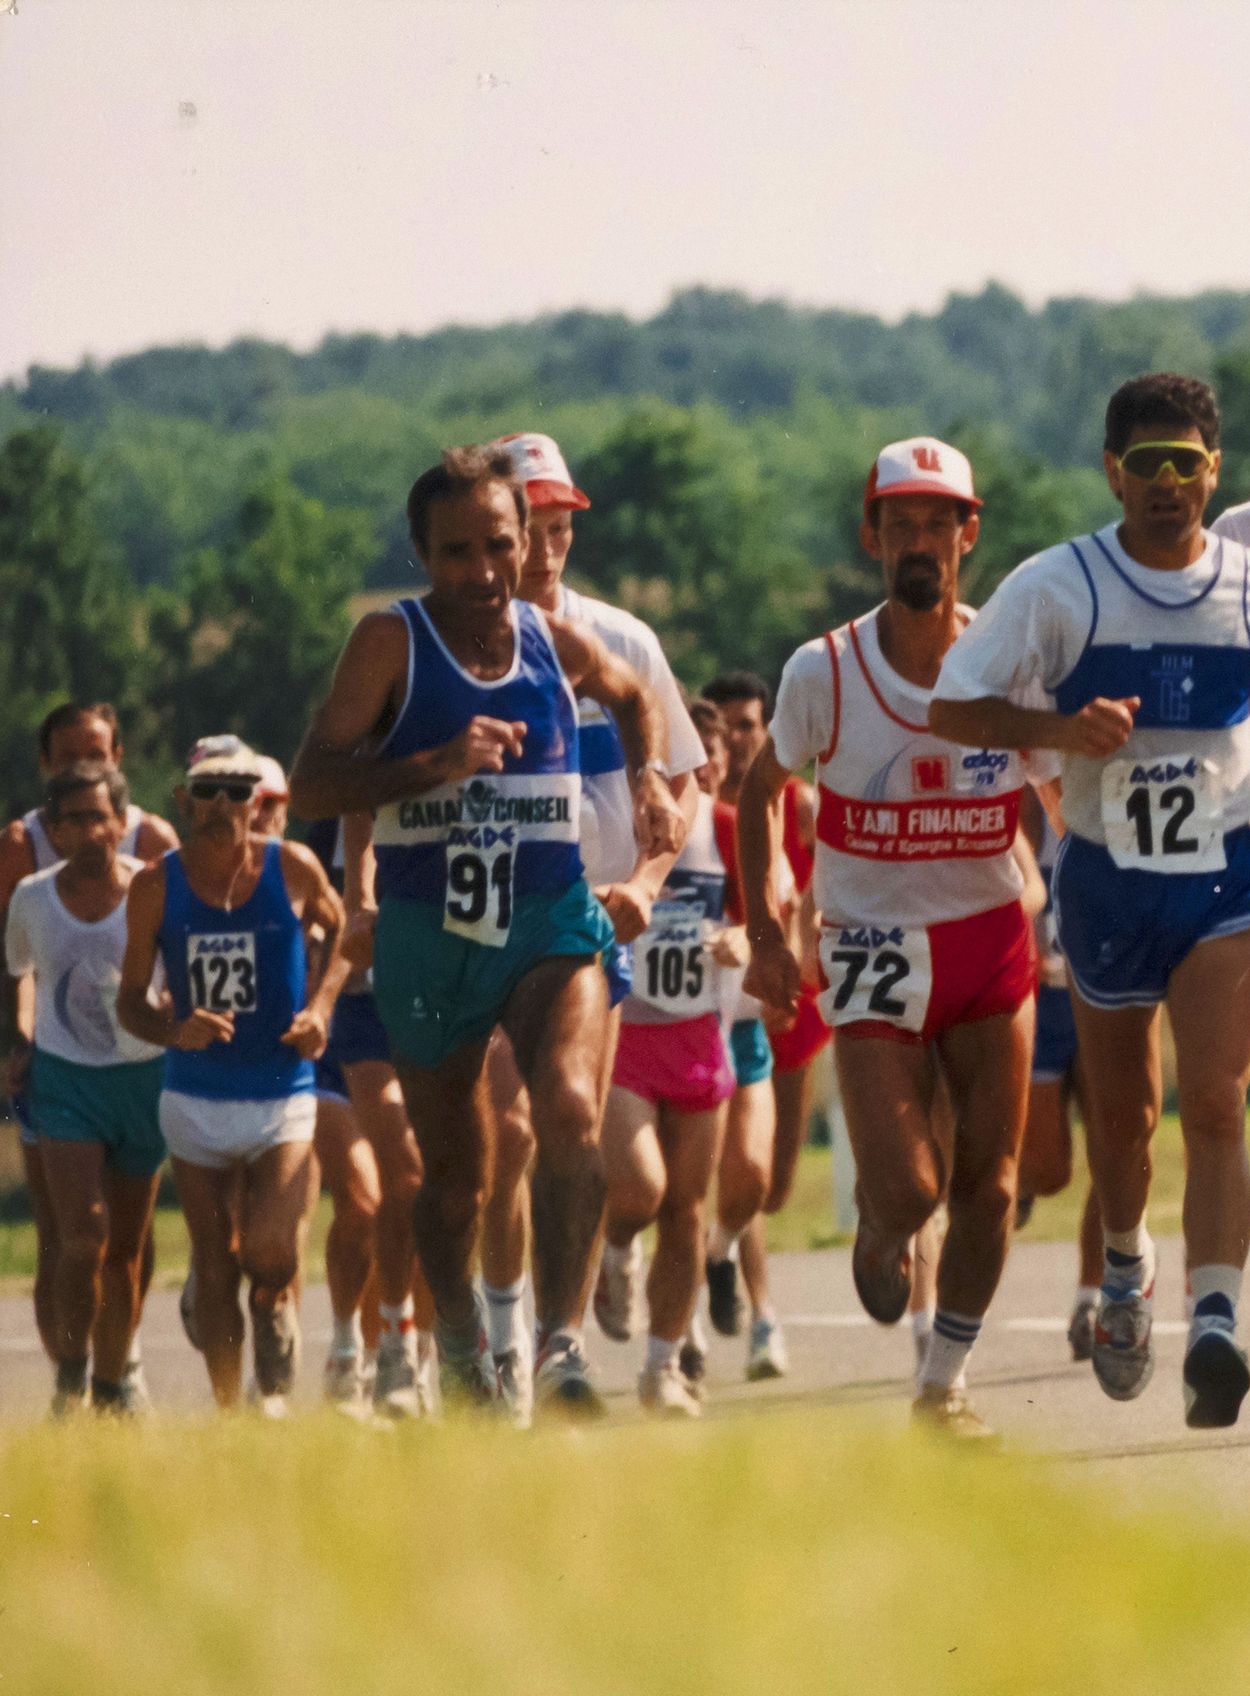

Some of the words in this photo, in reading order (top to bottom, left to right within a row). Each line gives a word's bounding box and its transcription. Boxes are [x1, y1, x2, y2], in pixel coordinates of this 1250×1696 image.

[1129, 757, 1198, 784] AGDE
[495, 796, 571, 824] CONSEIL
[845, 806, 898, 836] L'AMI
[908, 805, 1005, 835] FINANCIER
[1126, 786, 1199, 857] 12
[448, 825, 516, 850] AGDE
[447, 853, 512, 930] 91
[839, 927, 905, 948] AGDE
[190, 956, 256, 1009] 123
[646, 945, 704, 998] 105
[831, 950, 910, 1017] 72
